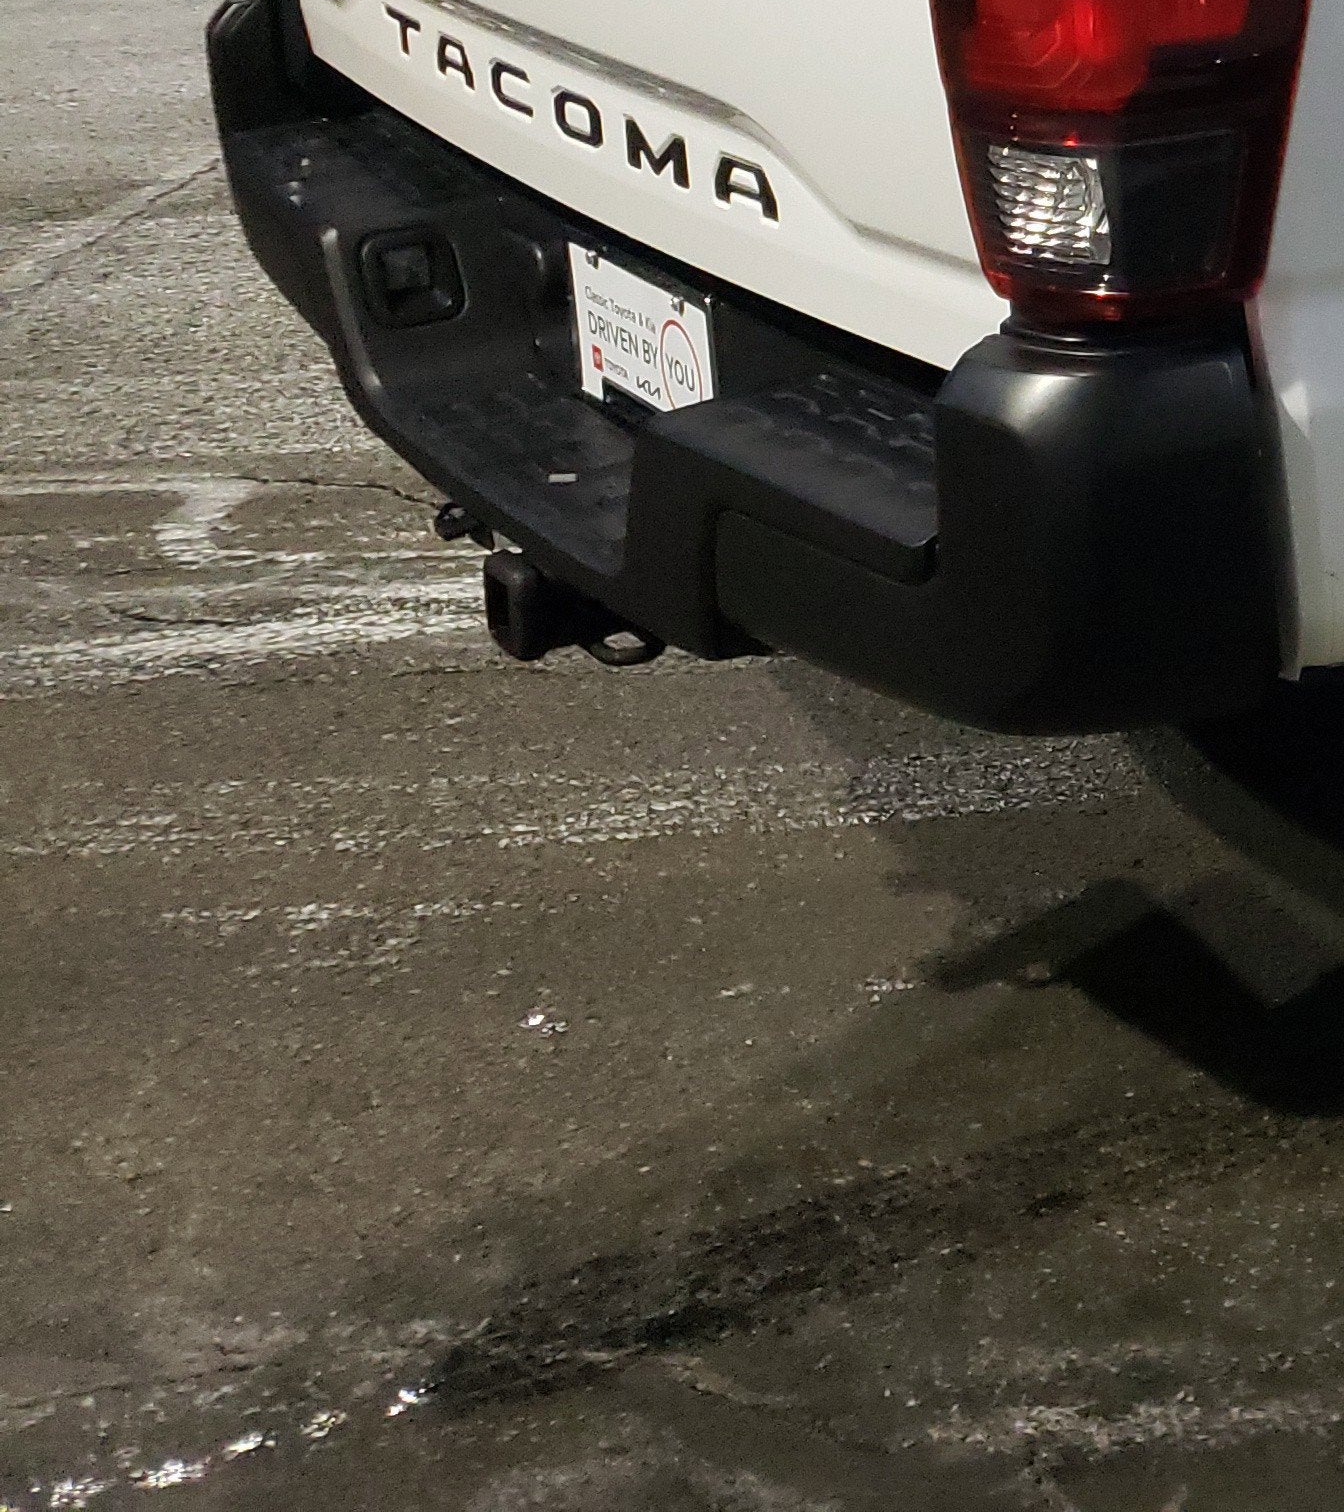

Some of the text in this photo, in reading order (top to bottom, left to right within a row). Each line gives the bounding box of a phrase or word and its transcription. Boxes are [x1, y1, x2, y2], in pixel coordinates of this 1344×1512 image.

[382, 2, 779, 225] TACOMA
[587, 310, 696, 392] DRIVEN BY YOU
